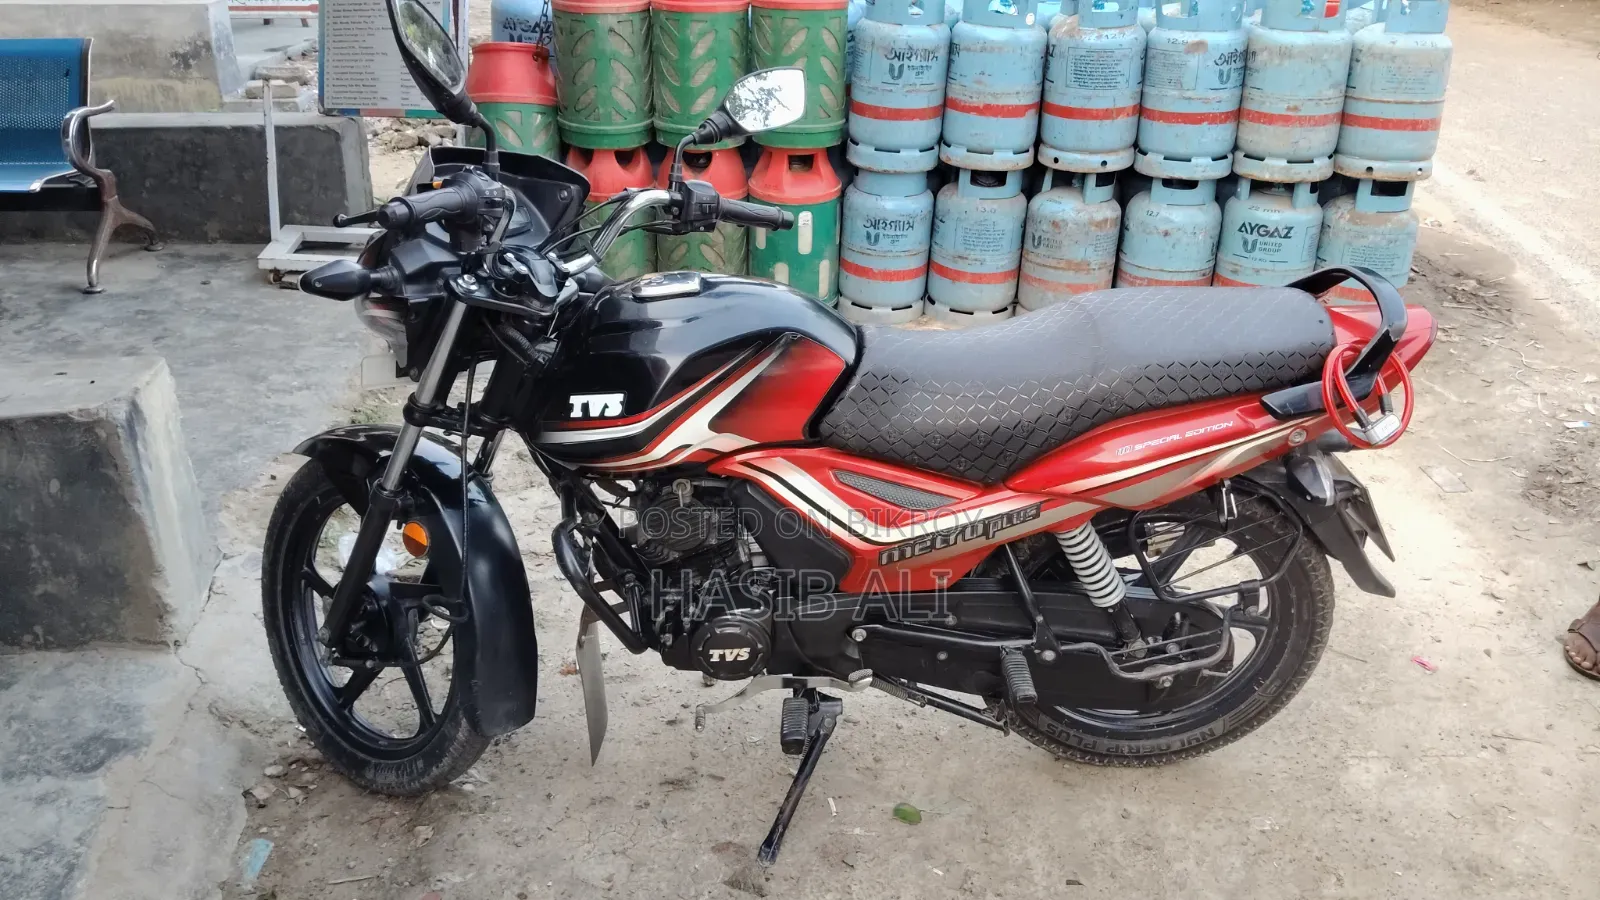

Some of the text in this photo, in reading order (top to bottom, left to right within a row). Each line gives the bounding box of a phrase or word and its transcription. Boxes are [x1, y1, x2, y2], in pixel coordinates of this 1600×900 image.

[1237, 221, 1295, 239] AYGAZ
[569, 393, 624, 418] TVS
[1134, 433, 1183, 451] SPECIAL
[1185, 421, 1234, 438] EDITION
[708, 647, 751, 662] TVS
